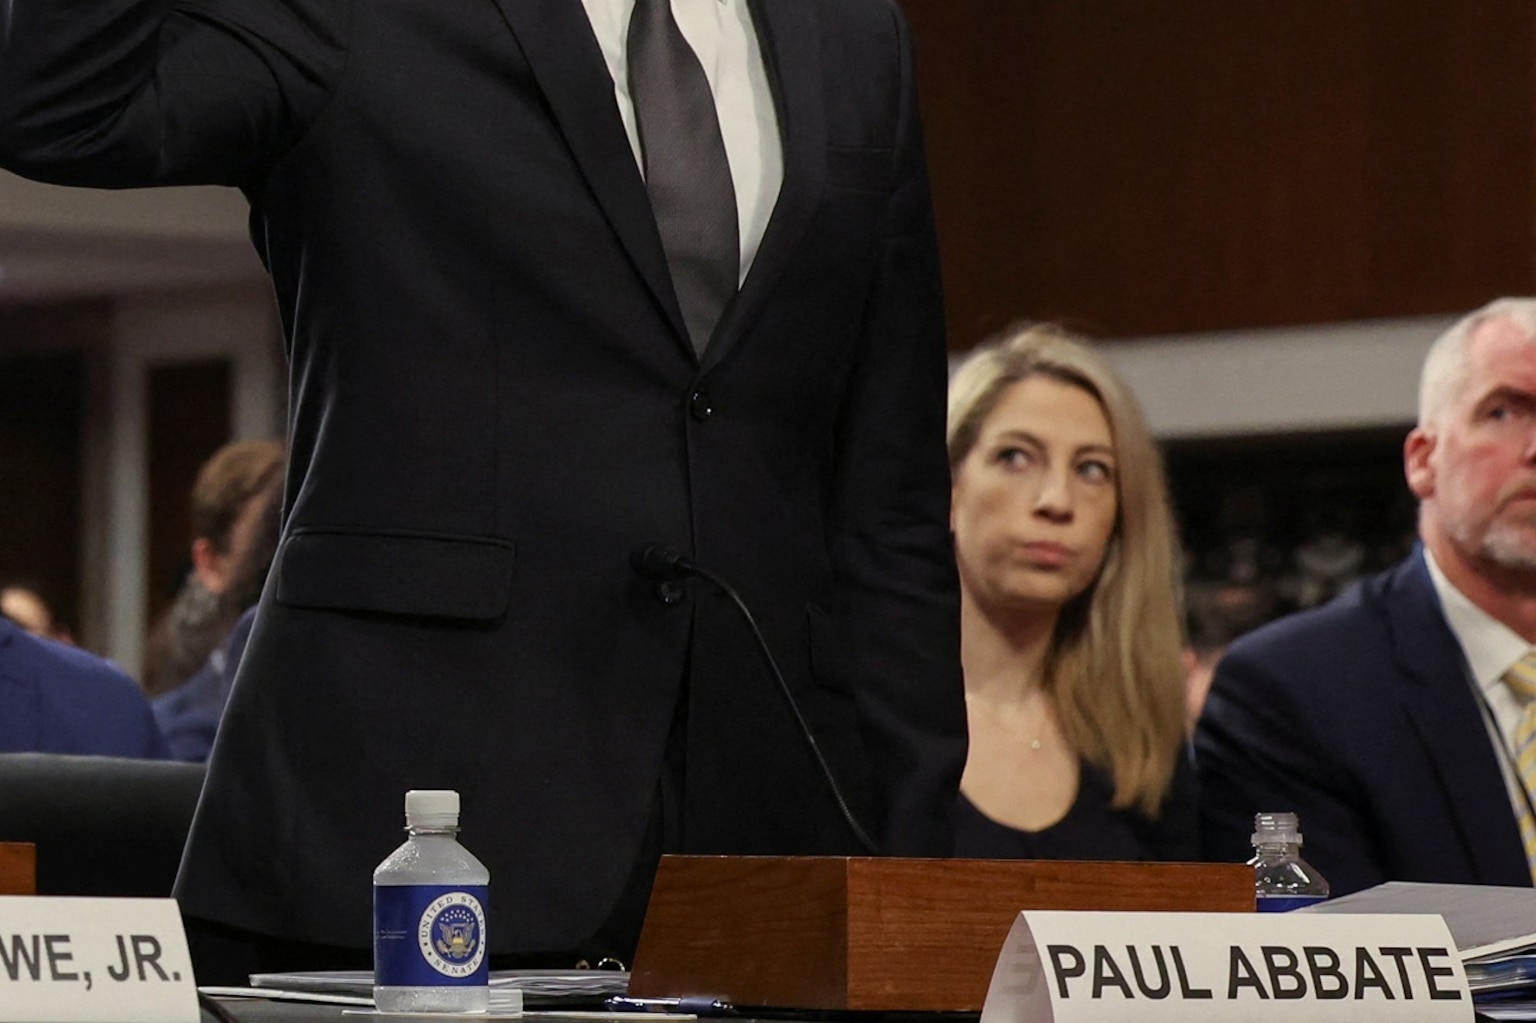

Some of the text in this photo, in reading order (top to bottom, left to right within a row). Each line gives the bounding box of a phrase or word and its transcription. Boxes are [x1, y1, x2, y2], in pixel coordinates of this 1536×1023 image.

[421, 896, 454, 938] UNITED
[107, 934, 182, 982] JR.
[434, 958, 478, 974] SENATE
[1046, 944, 1214, 1000] PAUL
[1227, 945, 1463, 1001] ABBATE
